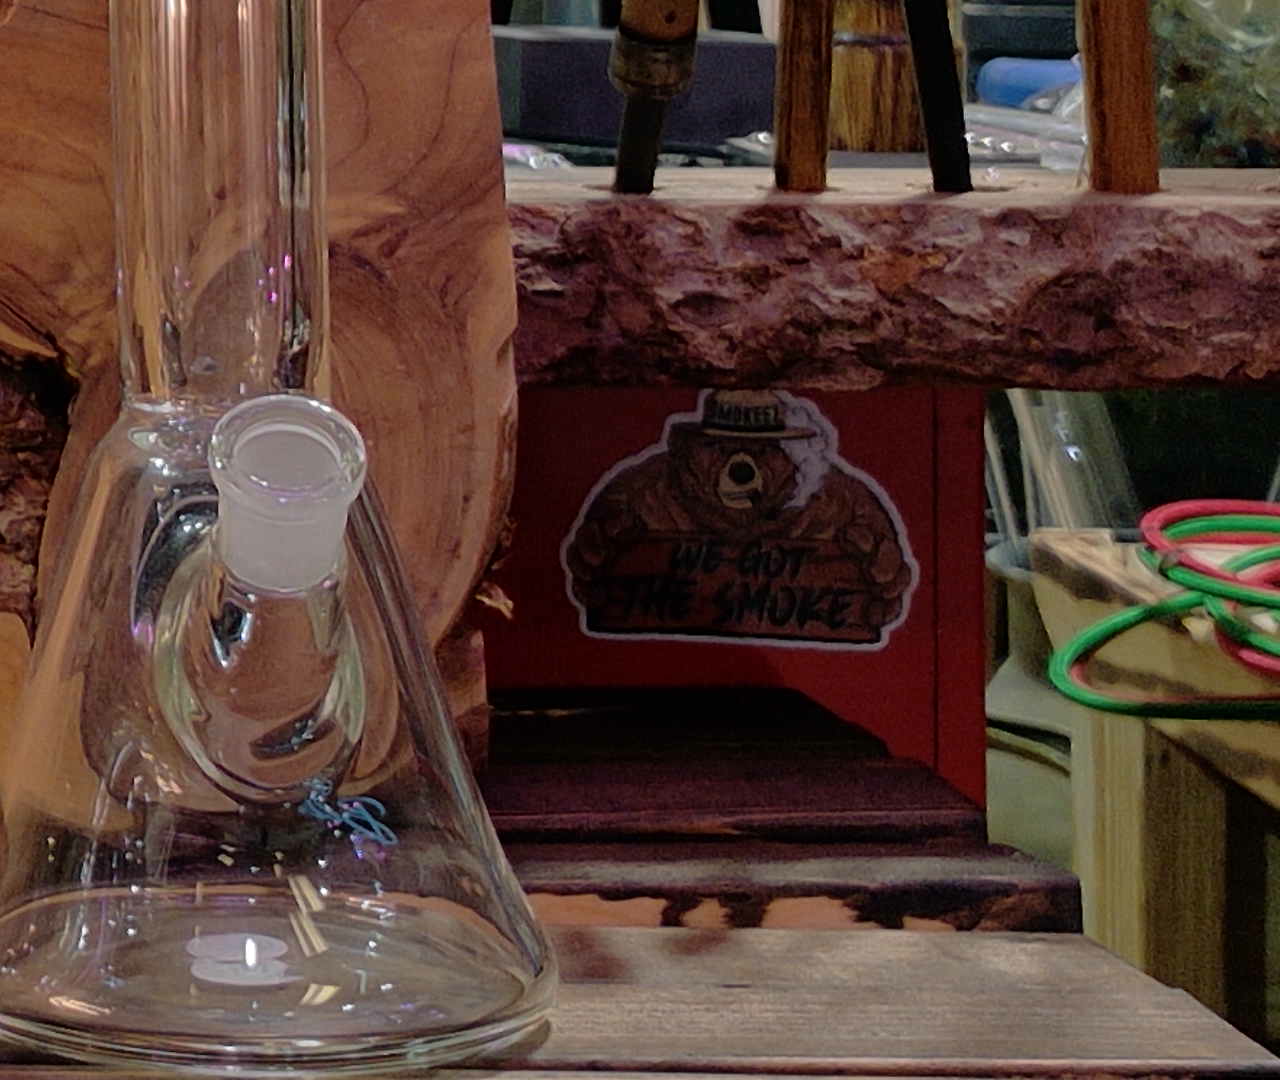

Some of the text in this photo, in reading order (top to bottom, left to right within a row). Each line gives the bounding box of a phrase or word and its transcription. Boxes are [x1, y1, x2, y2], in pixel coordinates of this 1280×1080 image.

[670, 538, 819, 579] WE GOT
[711, 582, 864, 631] SMOKE
